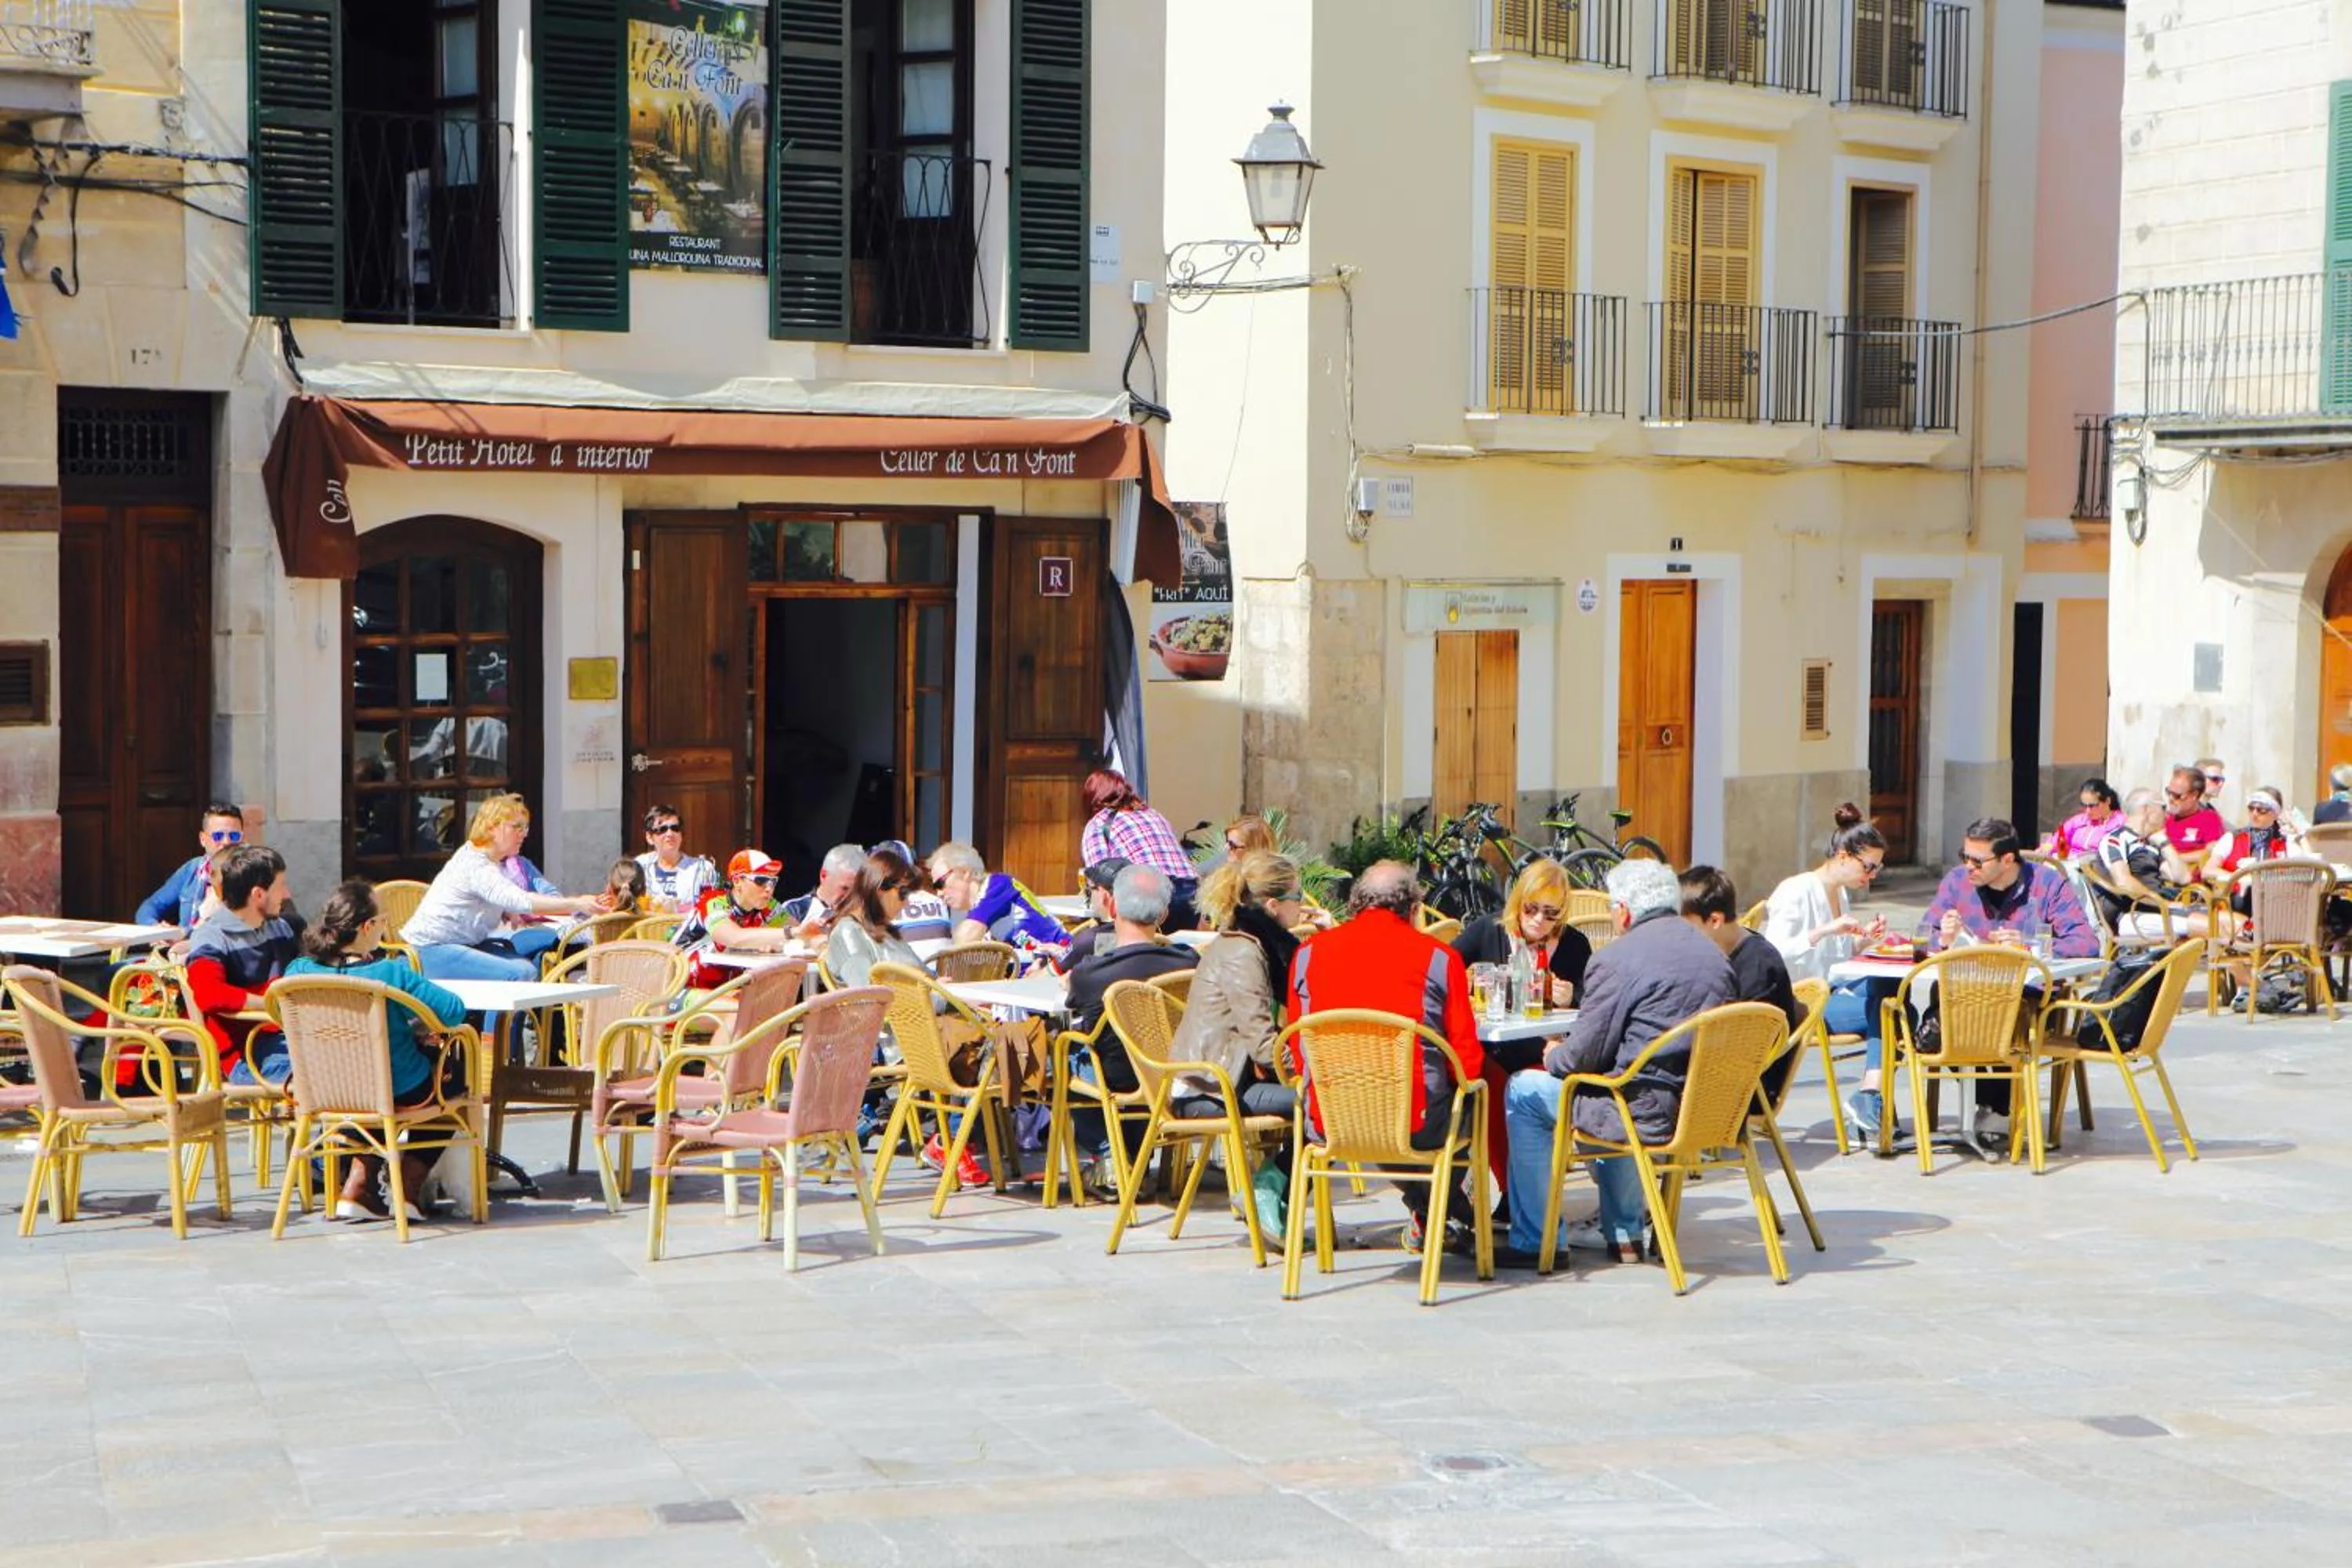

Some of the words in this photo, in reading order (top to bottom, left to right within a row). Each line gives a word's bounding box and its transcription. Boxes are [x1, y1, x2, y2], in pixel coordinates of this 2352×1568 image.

[669, 235, 720, 250] RESTAURANT
[405, 434, 464, 465] Petit
[470, 438, 535, 465] Hotel
[577, 445, 652, 468] interior
[880, 449, 938, 473] Celler
[946, 449, 965, 473] de
[1025, 447, 1076, 474] Font
